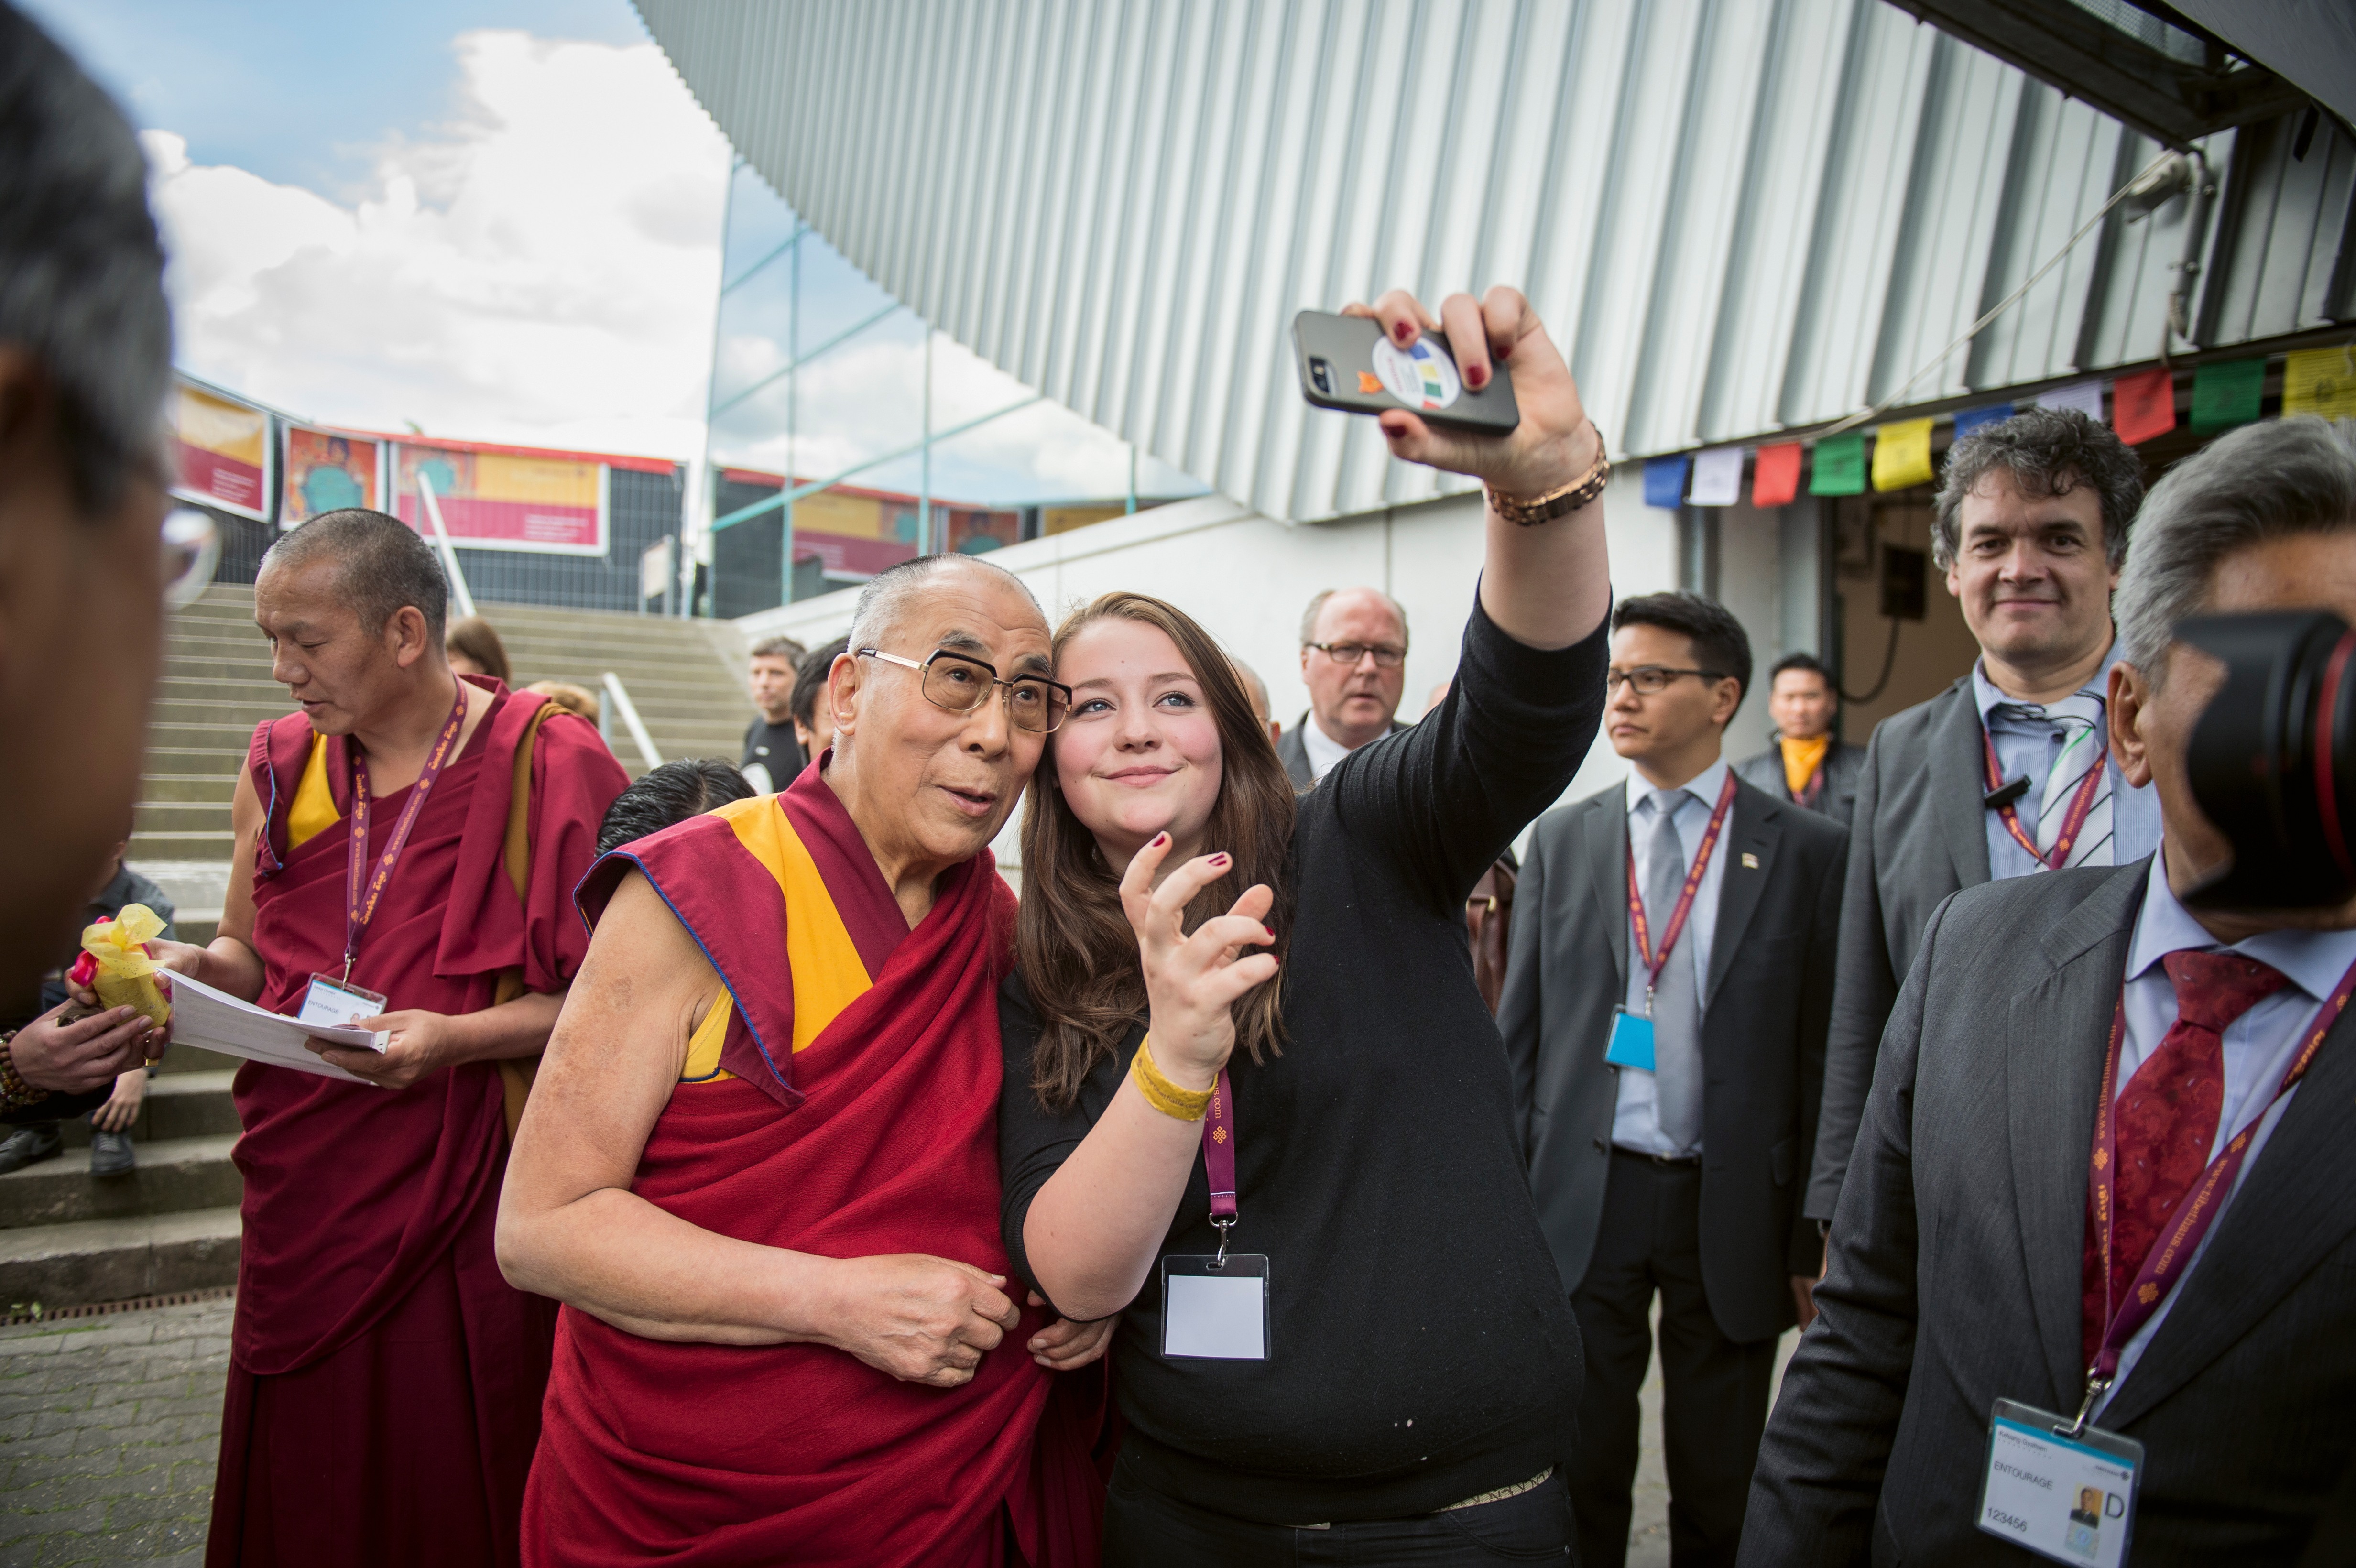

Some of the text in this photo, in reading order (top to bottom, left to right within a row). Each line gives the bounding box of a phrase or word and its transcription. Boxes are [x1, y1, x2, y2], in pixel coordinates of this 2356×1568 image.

[308, 999, 339, 1014] ENTOURAGE
[2154, 1158, 2229, 1275] www.tibethaus.com
[1994, 1460, 2054, 1491] ENTOURAGE
[1987, 1506, 2028, 1532] 123456
[2105, 1492, 2125, 1519] D
